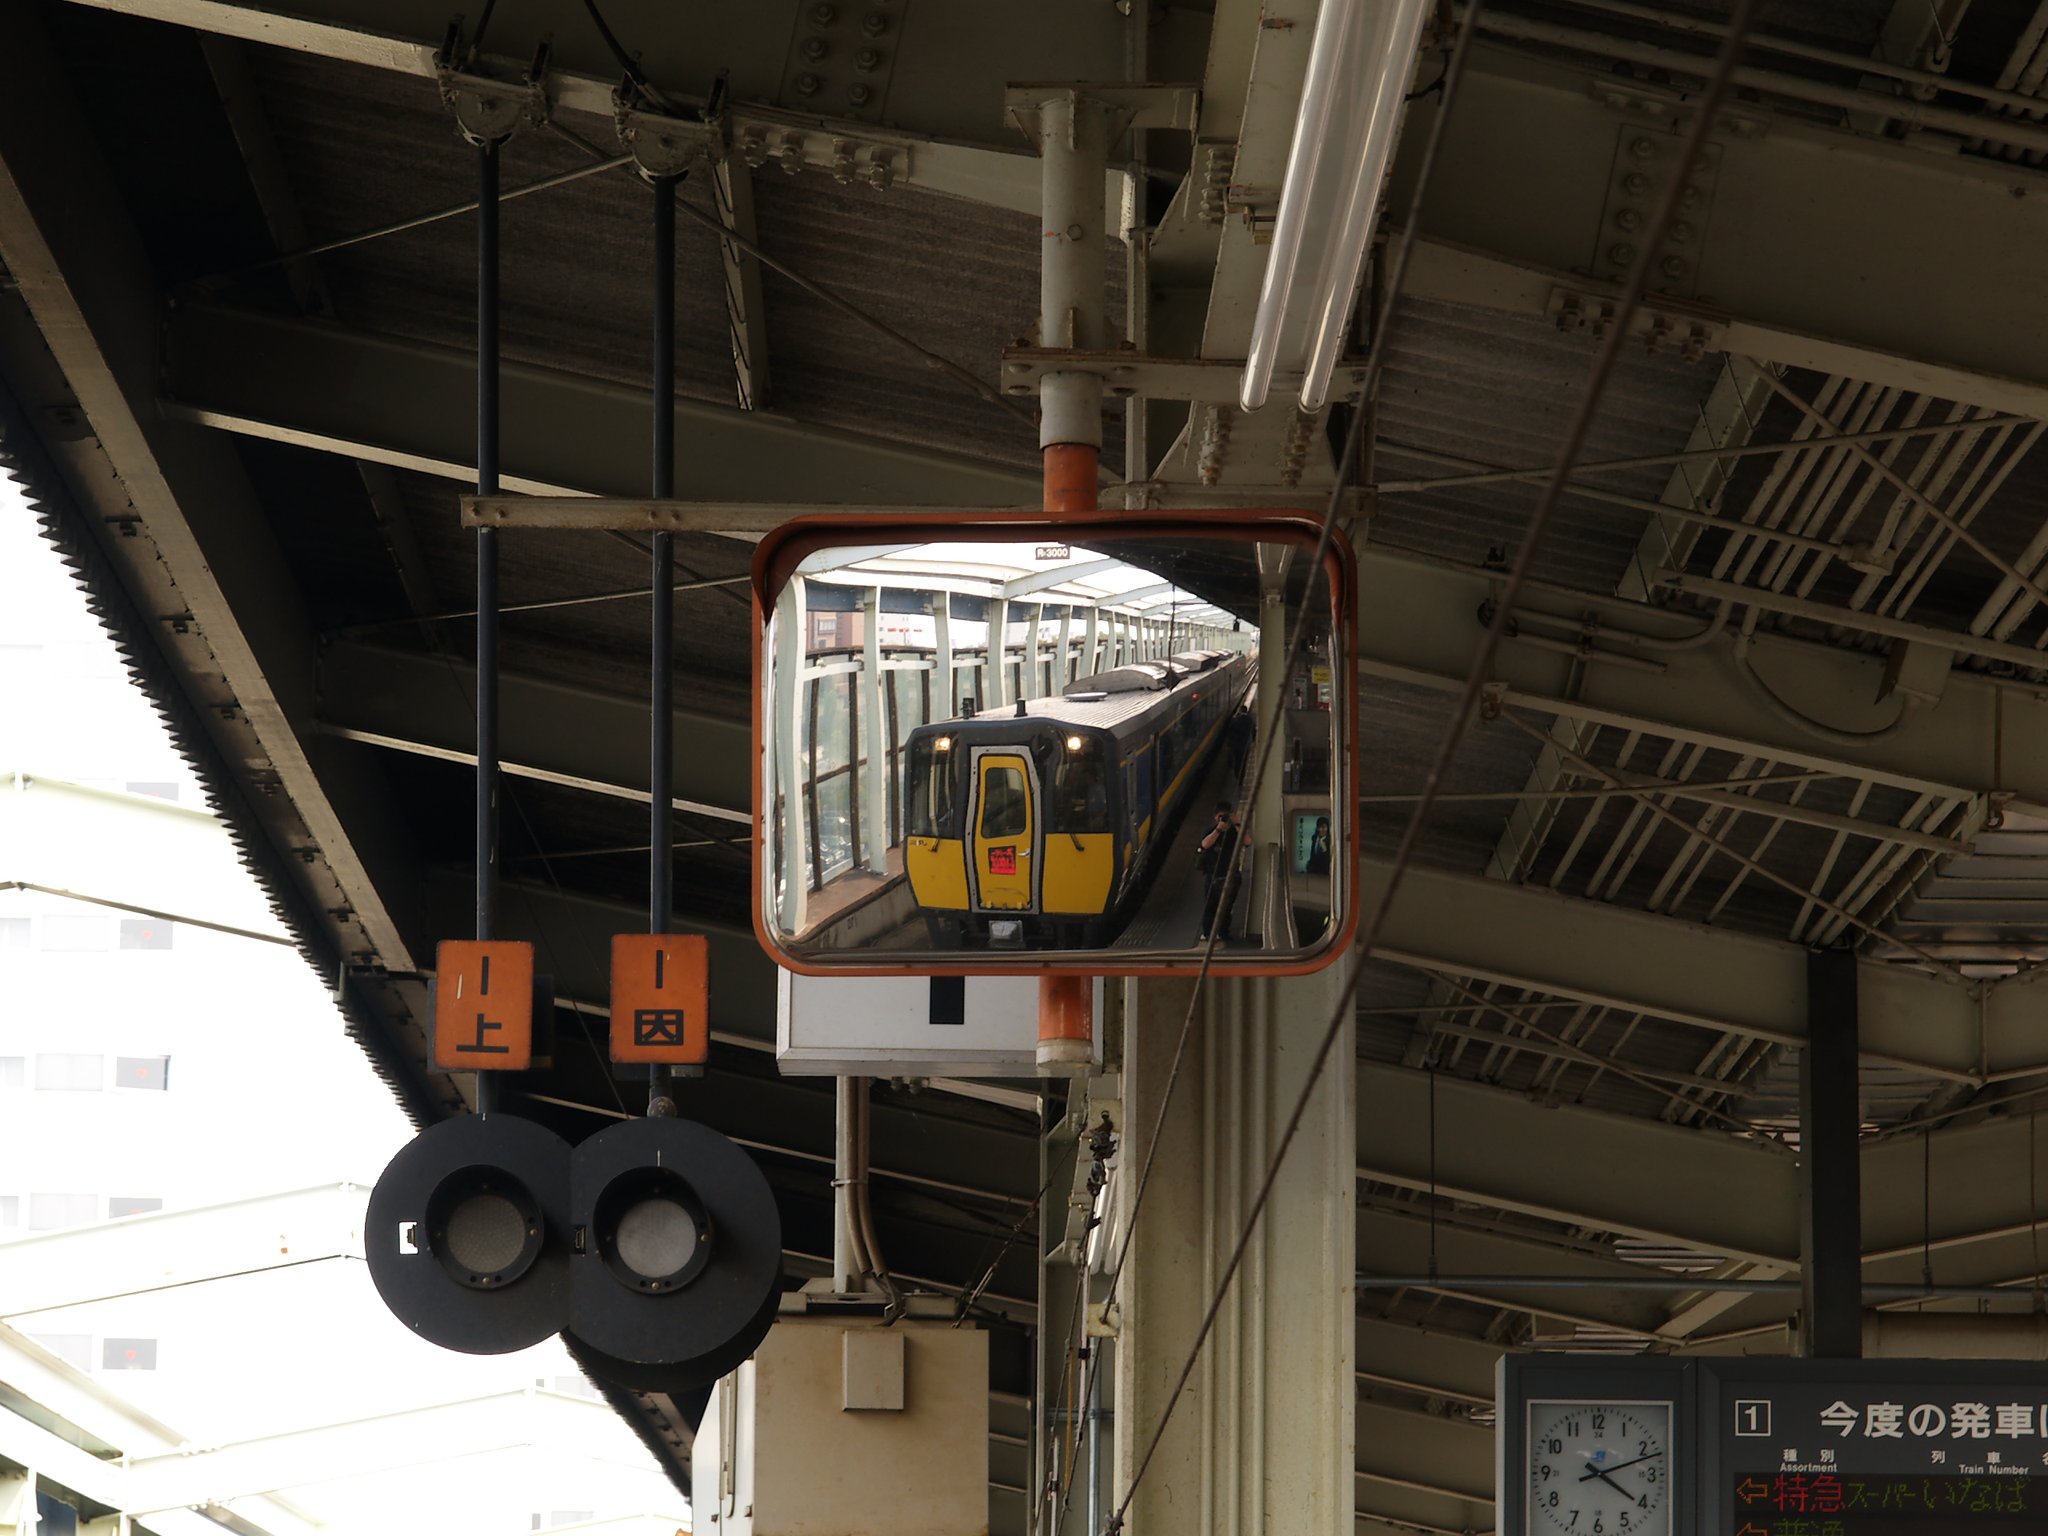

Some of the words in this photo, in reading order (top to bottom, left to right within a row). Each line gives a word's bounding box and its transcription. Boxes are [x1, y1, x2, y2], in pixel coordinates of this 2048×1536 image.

[1592, 1414, 1605, 1430] 12
[1744, 1405, 1757, 1431] 1
[1820, 1400, 2048, 1439] 今度の発車
[1568, 1422, 1579, 1437] 11
[1549, 1439, 1562, 1454] 10
[1638, 1441, 1648, 1456] 2
[1541, 1465, 1551, 1481] 9
[1647, 1467, 1656, 1483] 3
[1779, 1462, 1838, 1473] Assortment
[1959, 1464, 1984, 1474] Train
[1989, 1464, 2029, 1475] Number
[1549, 1491, 1559, 1507] 8
[1773, 1473, 1846, 1512] 特急
[1637, 1494, 1648, 1509] 4
[1569, 1510, 1579, 1526] 7
[1593, 1518, 1603, 1533] 6
[1619, 1511, 1629, 1527] 5
